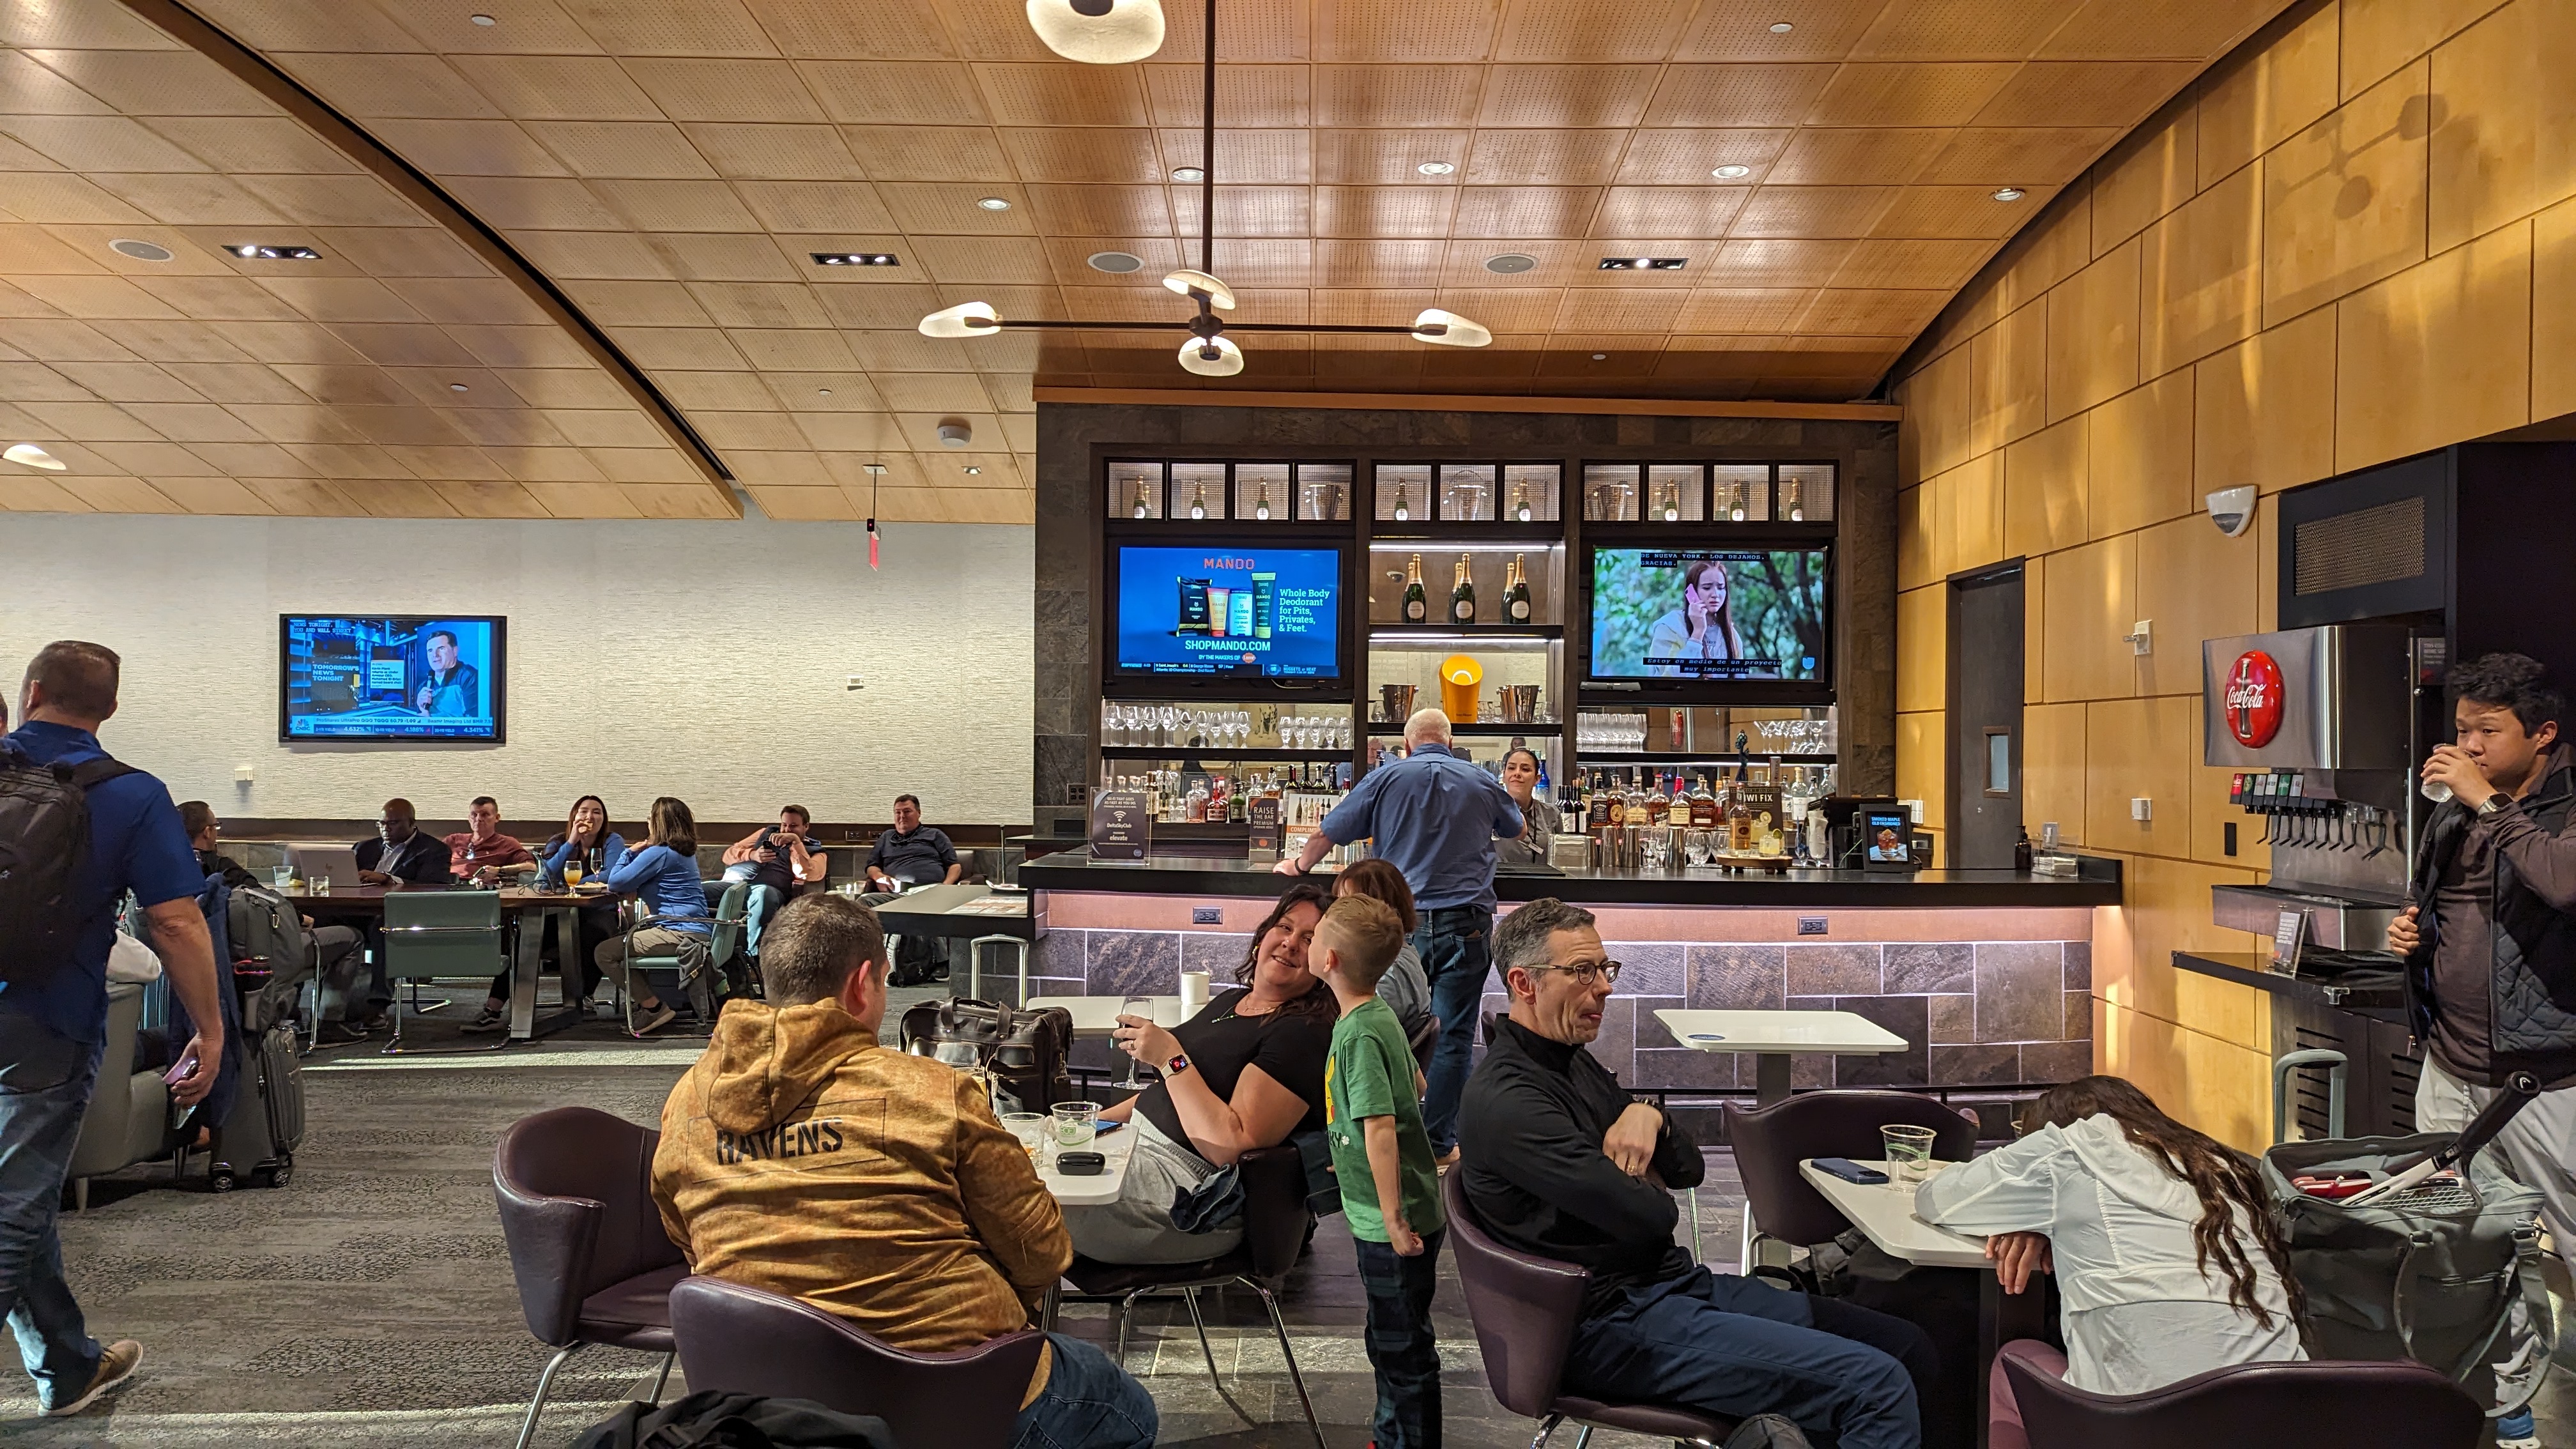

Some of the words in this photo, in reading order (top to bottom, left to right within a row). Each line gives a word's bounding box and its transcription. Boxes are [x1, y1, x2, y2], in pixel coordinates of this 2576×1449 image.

[1204, 558, 1255, 570] MANDO
[1279, 588, 1307, 597] Whole
[1308, 589, 1330, 599] Body
[1279, 597, 1323, 606] Deodorant
[1279, 606, 1290, 615] for
[1291, 606, 1312, 616] Pits,
[1279, 615, 1316, 625] Privates,
[1185, 640, 1271, 651] SHOPMANDO.COM
[2227, 684, 2267, 710] Coca-Cola
[1744, 793, 1758, 802] IWI
[1254, 806, 1274, 815] RAISE
[716, 1117, 843, 1165] RAVENS
